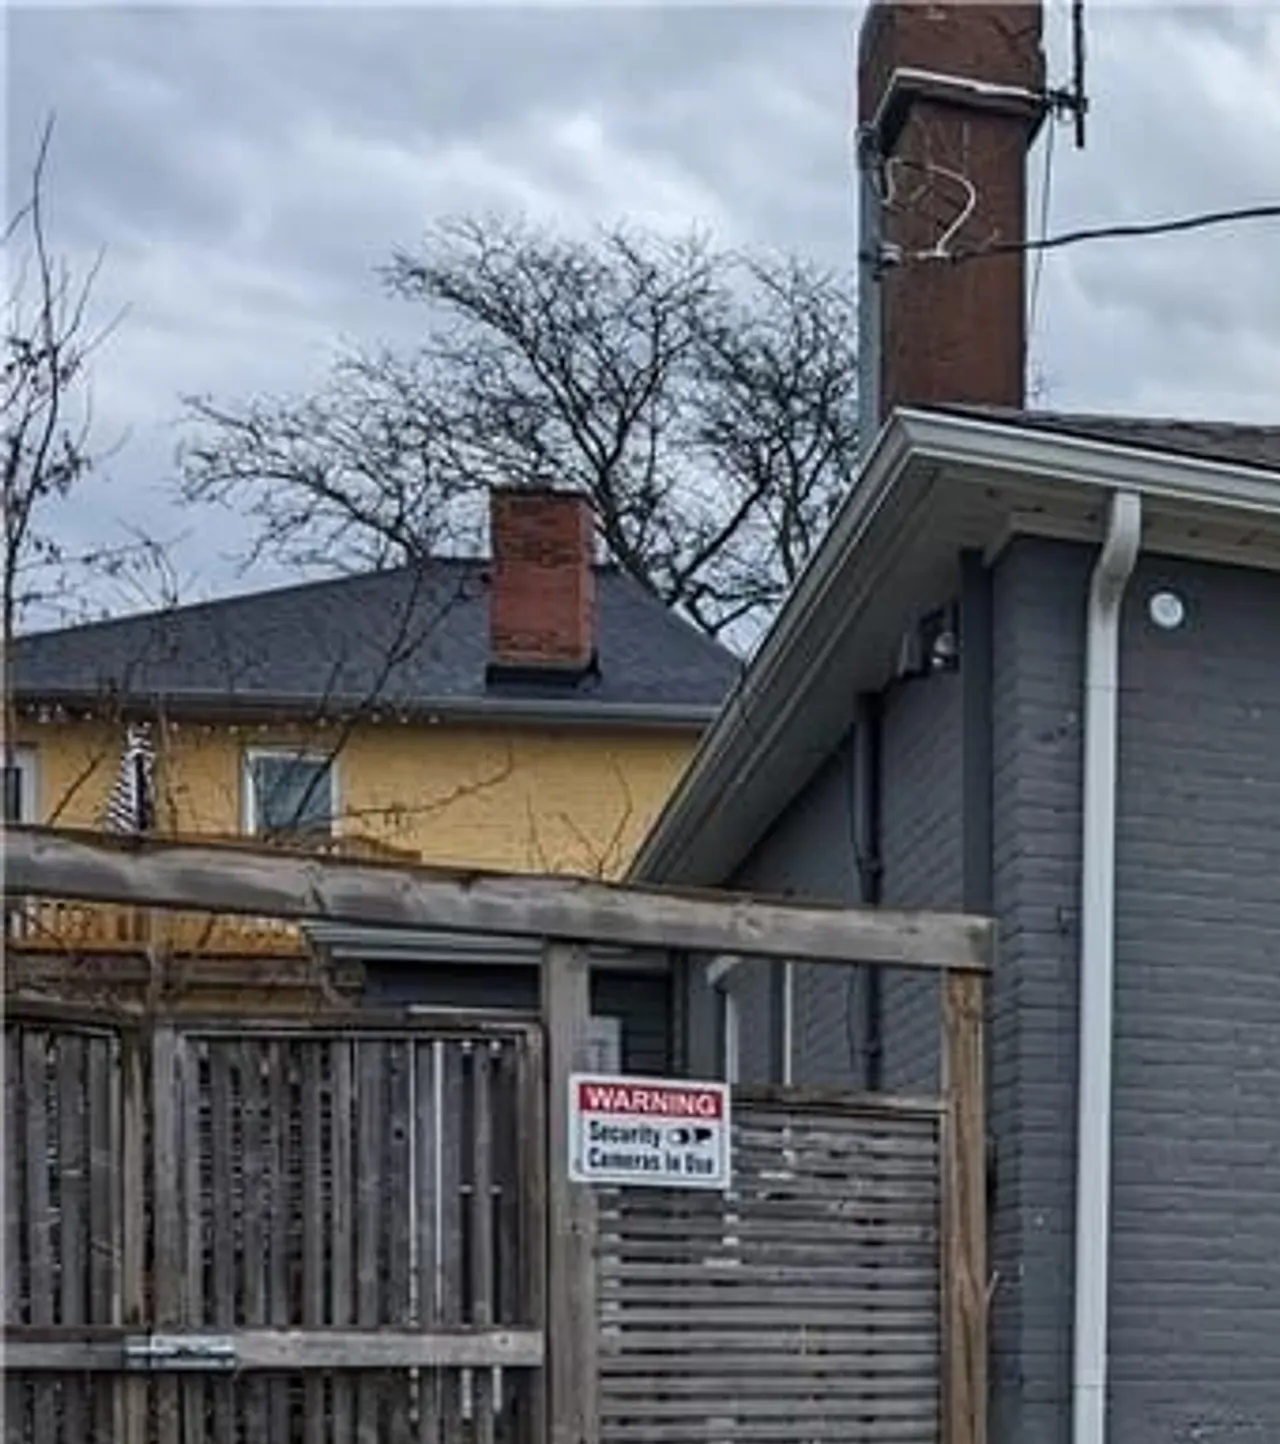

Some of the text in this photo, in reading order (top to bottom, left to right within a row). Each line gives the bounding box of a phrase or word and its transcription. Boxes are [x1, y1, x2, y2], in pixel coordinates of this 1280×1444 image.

[588, 1087, 717, 1116] WARNING
[589, 1121, 661, 1147] Security
[589, 1147, 661, 1171] Cameras
